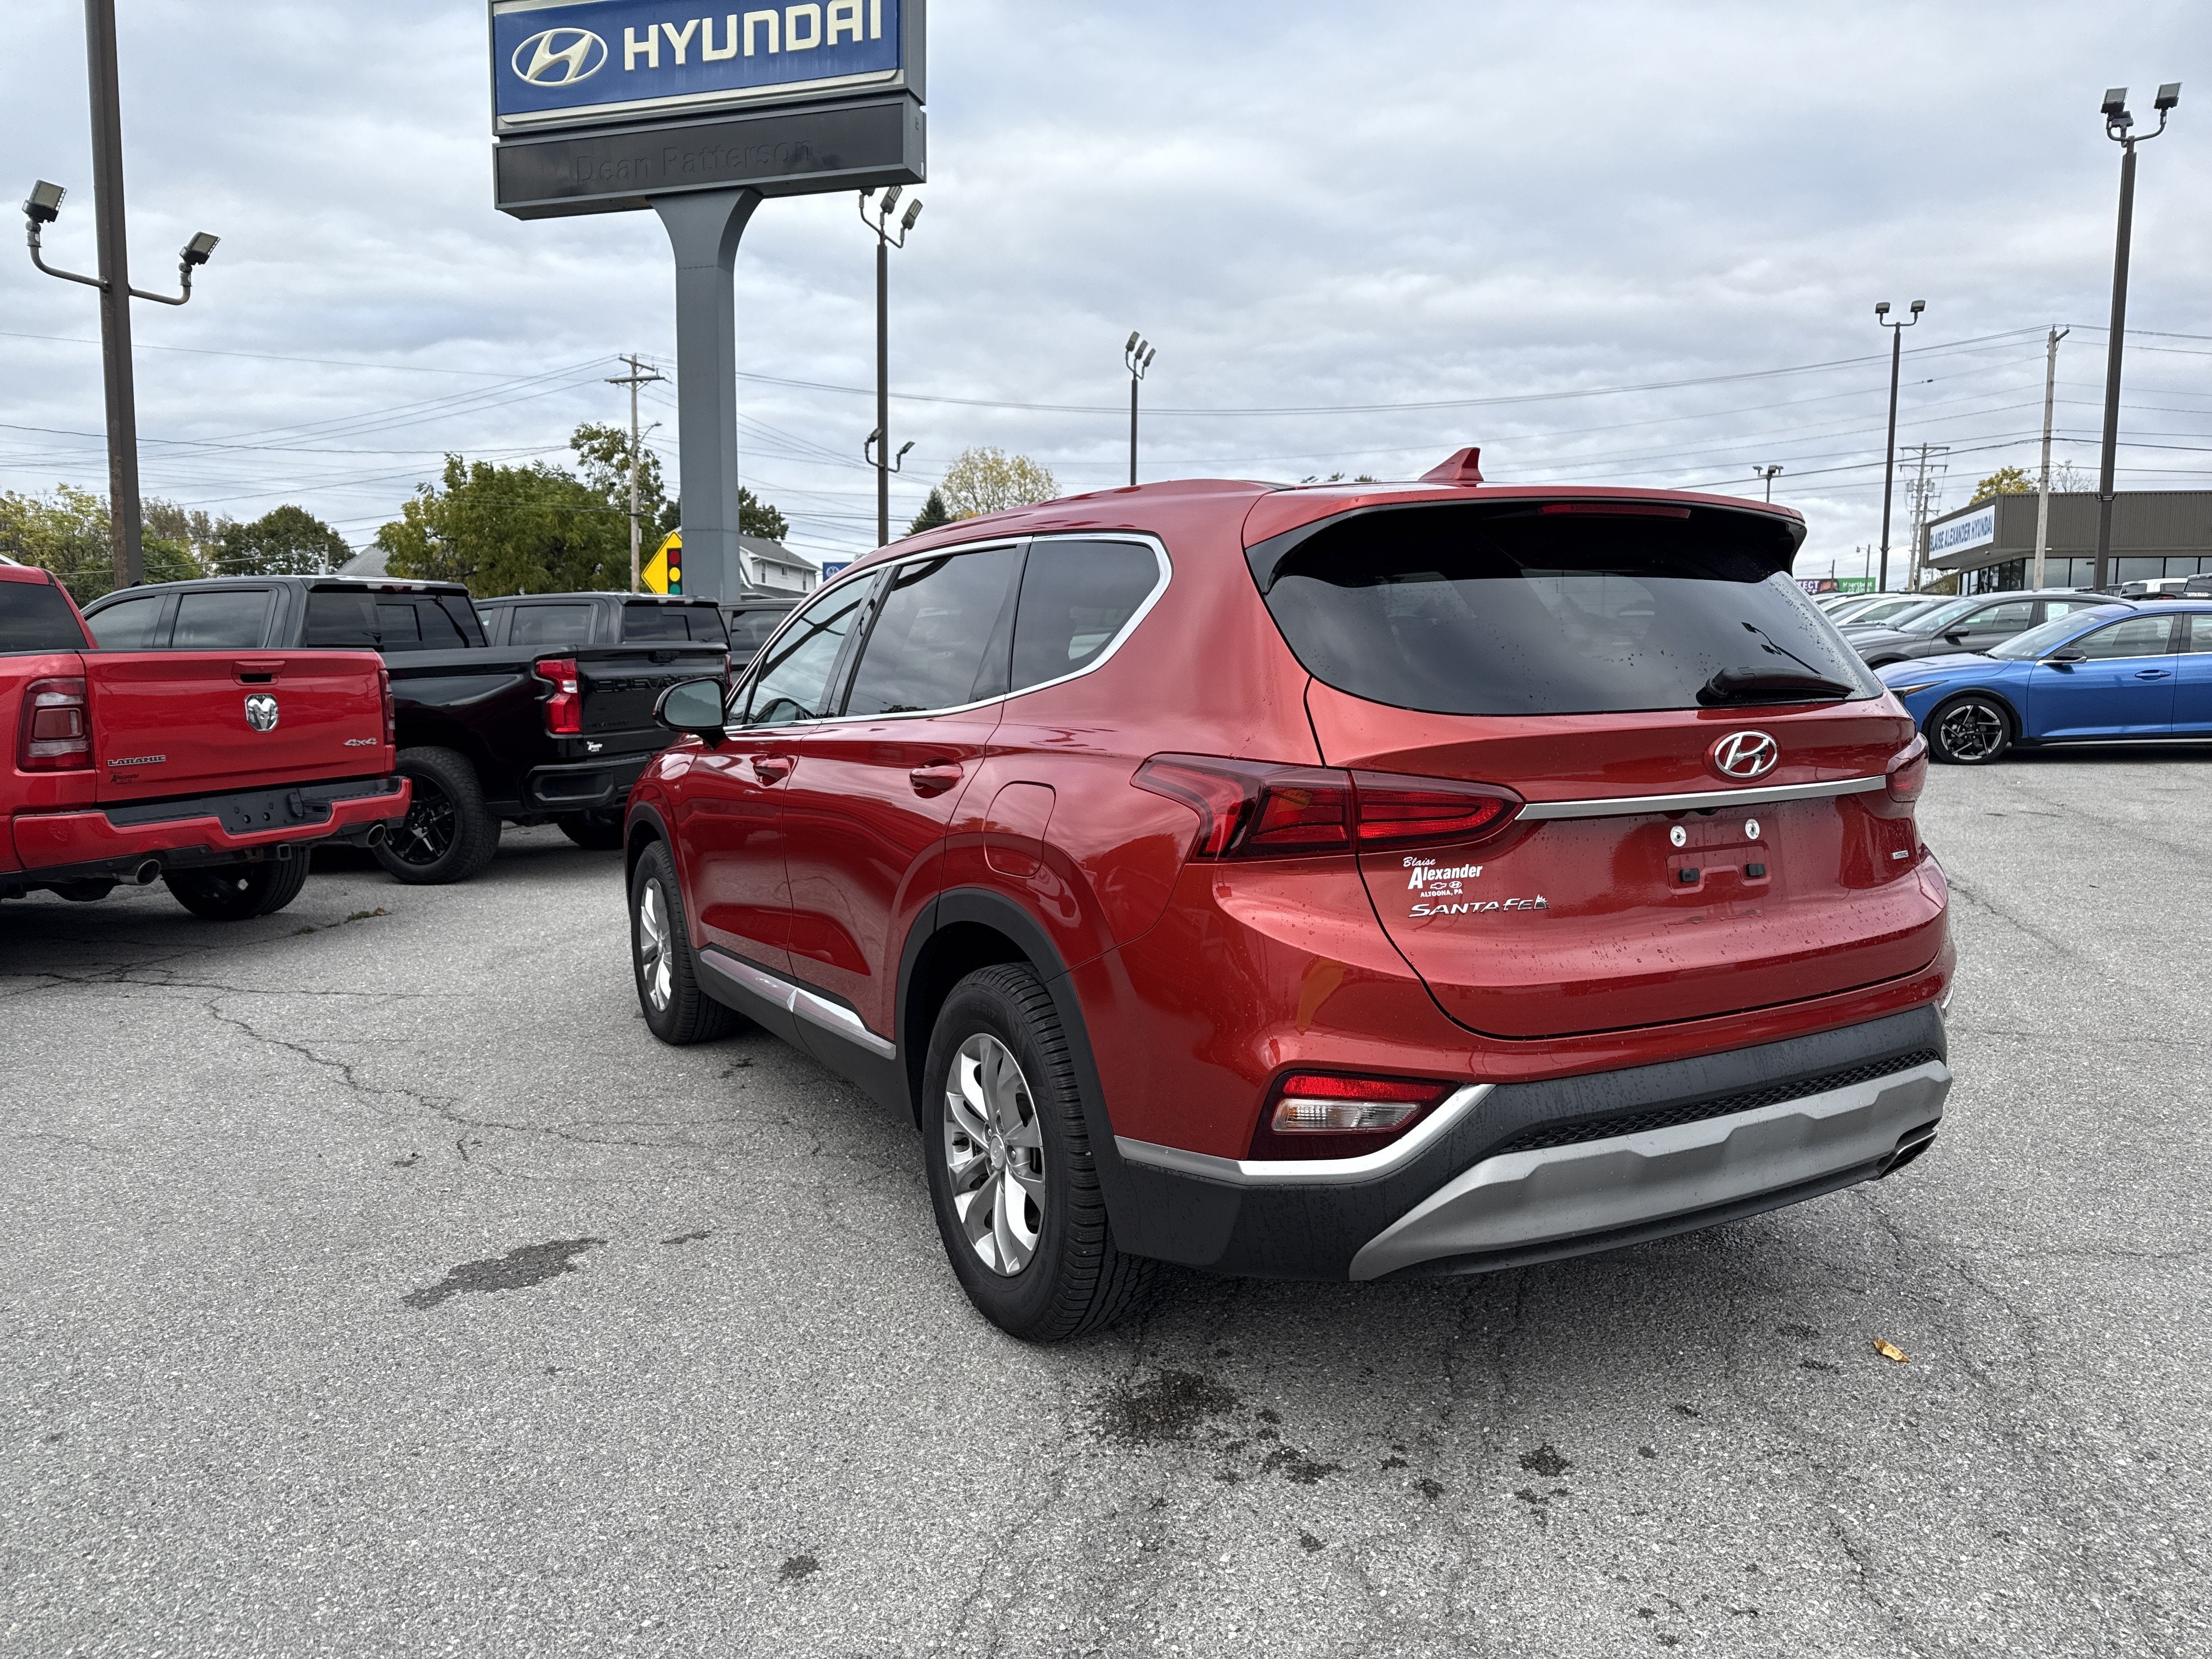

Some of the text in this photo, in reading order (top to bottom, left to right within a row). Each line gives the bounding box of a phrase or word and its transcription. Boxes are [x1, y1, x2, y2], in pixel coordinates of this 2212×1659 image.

[623, 0, 882, 71] HYUNDAI
[576, 139, 812, 184] Dean Patterson
[1929, 514, 1993, 552] BLAISE ALEXANDER HYUNDAI
[107, 755, 166, 767] LARAMIE
[1403, 856, 1436, 867] Blaise
[1407, 864, 1483, 890] Alexander
[1408, 901, 1500, 918] SANTA
